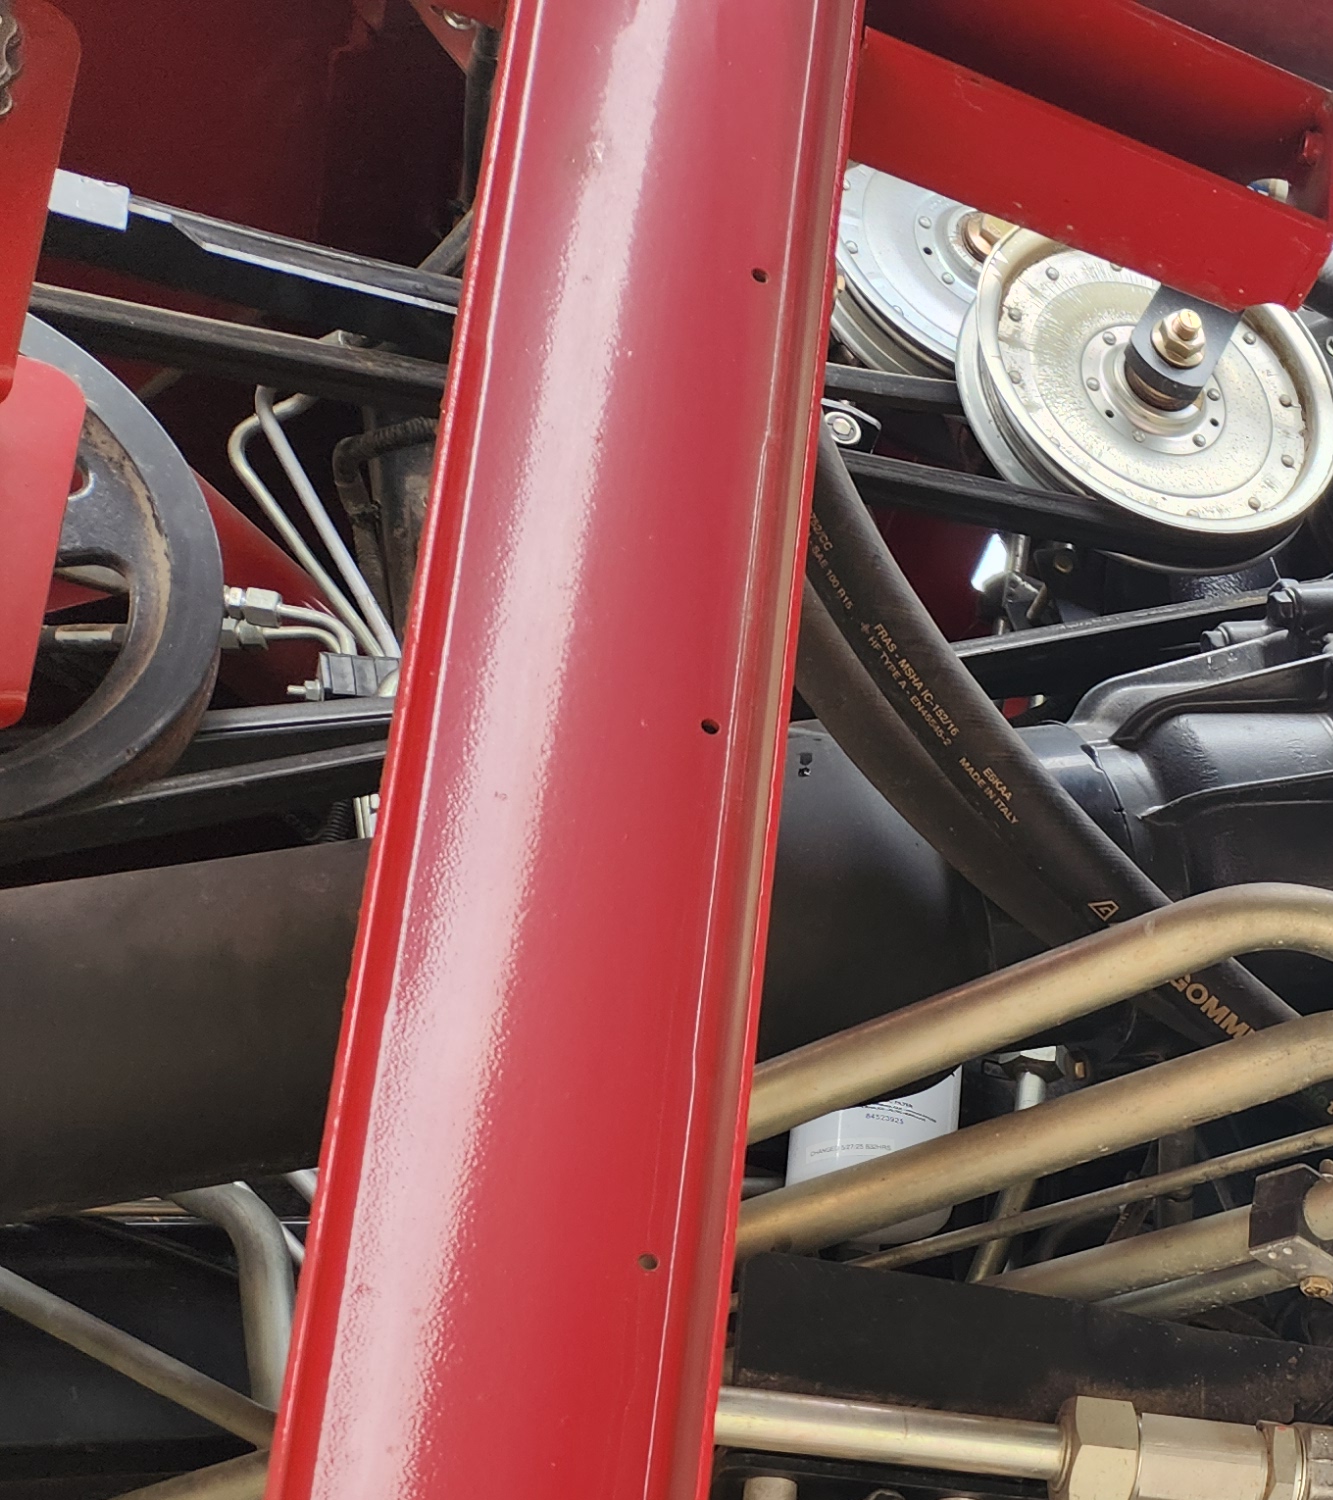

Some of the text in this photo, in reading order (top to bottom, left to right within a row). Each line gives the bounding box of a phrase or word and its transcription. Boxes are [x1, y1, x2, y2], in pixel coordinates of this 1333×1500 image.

[823, 568, 841, 589] 100
[872, 622, 898, 653] FRAS
[897, 657, 925, 691] MSHA
[877, 649, 902, 680] TYPE
[957, 756, 1019, 826] MADE IN ITALY
